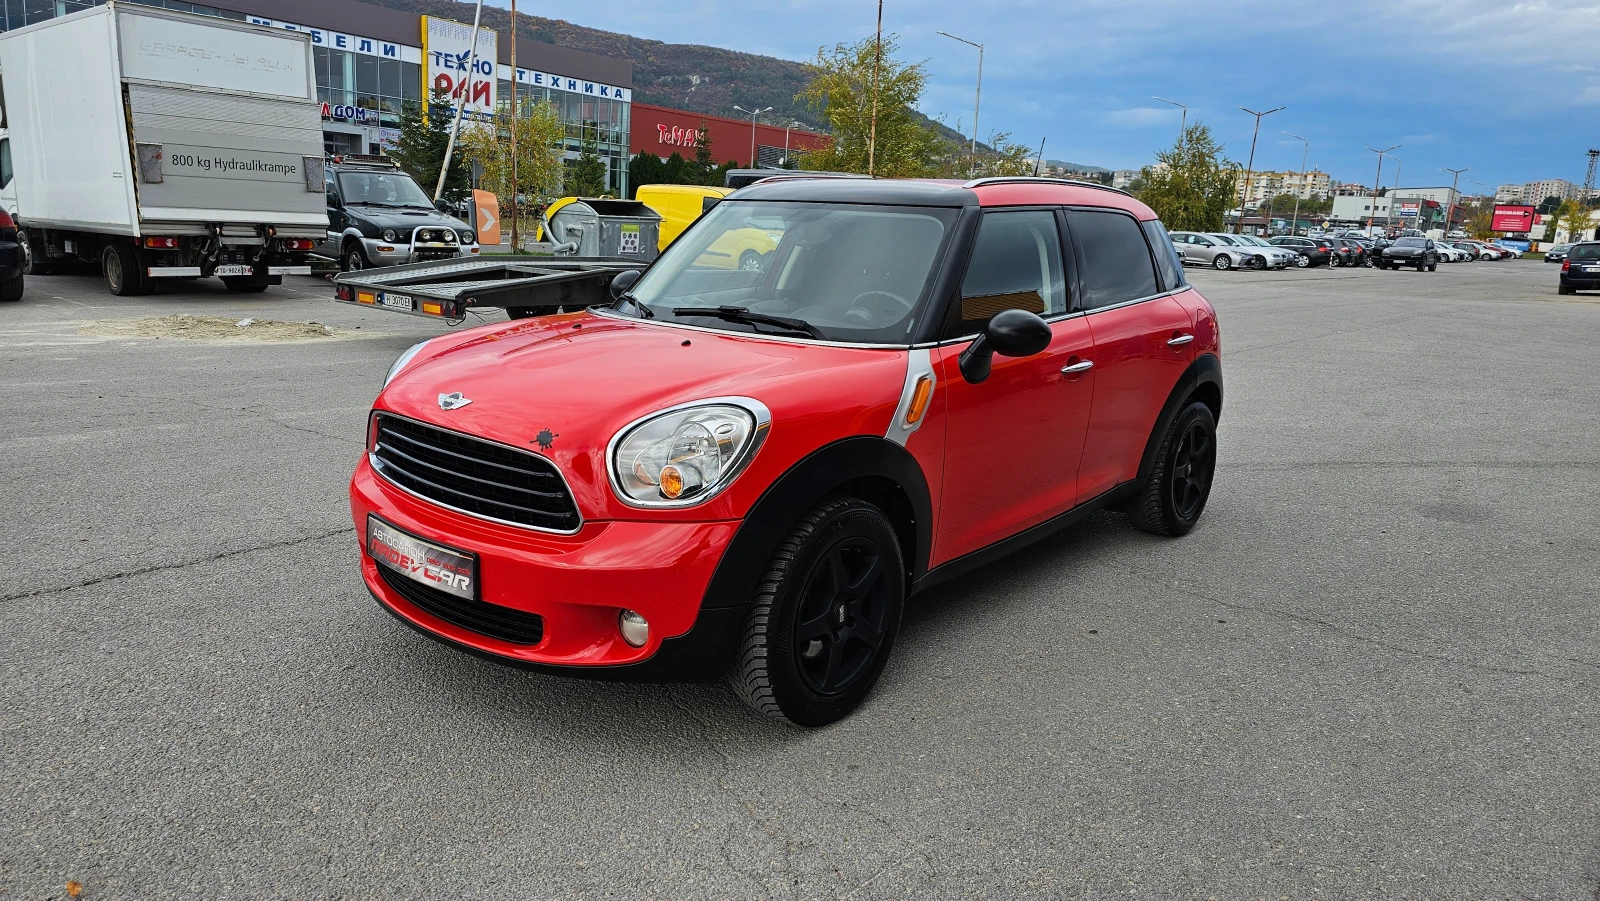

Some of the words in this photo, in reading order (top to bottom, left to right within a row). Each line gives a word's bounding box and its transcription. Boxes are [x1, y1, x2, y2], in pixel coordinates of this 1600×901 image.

[433, 49, 493, 76] ТЕХНО
[516, 69, 623, 99] ТЕХНИКА
[171, 154, 194, 167] 800
[197, 155, 211, 171] kg
[214, 157, 297, 176] Hydraulikrampe
